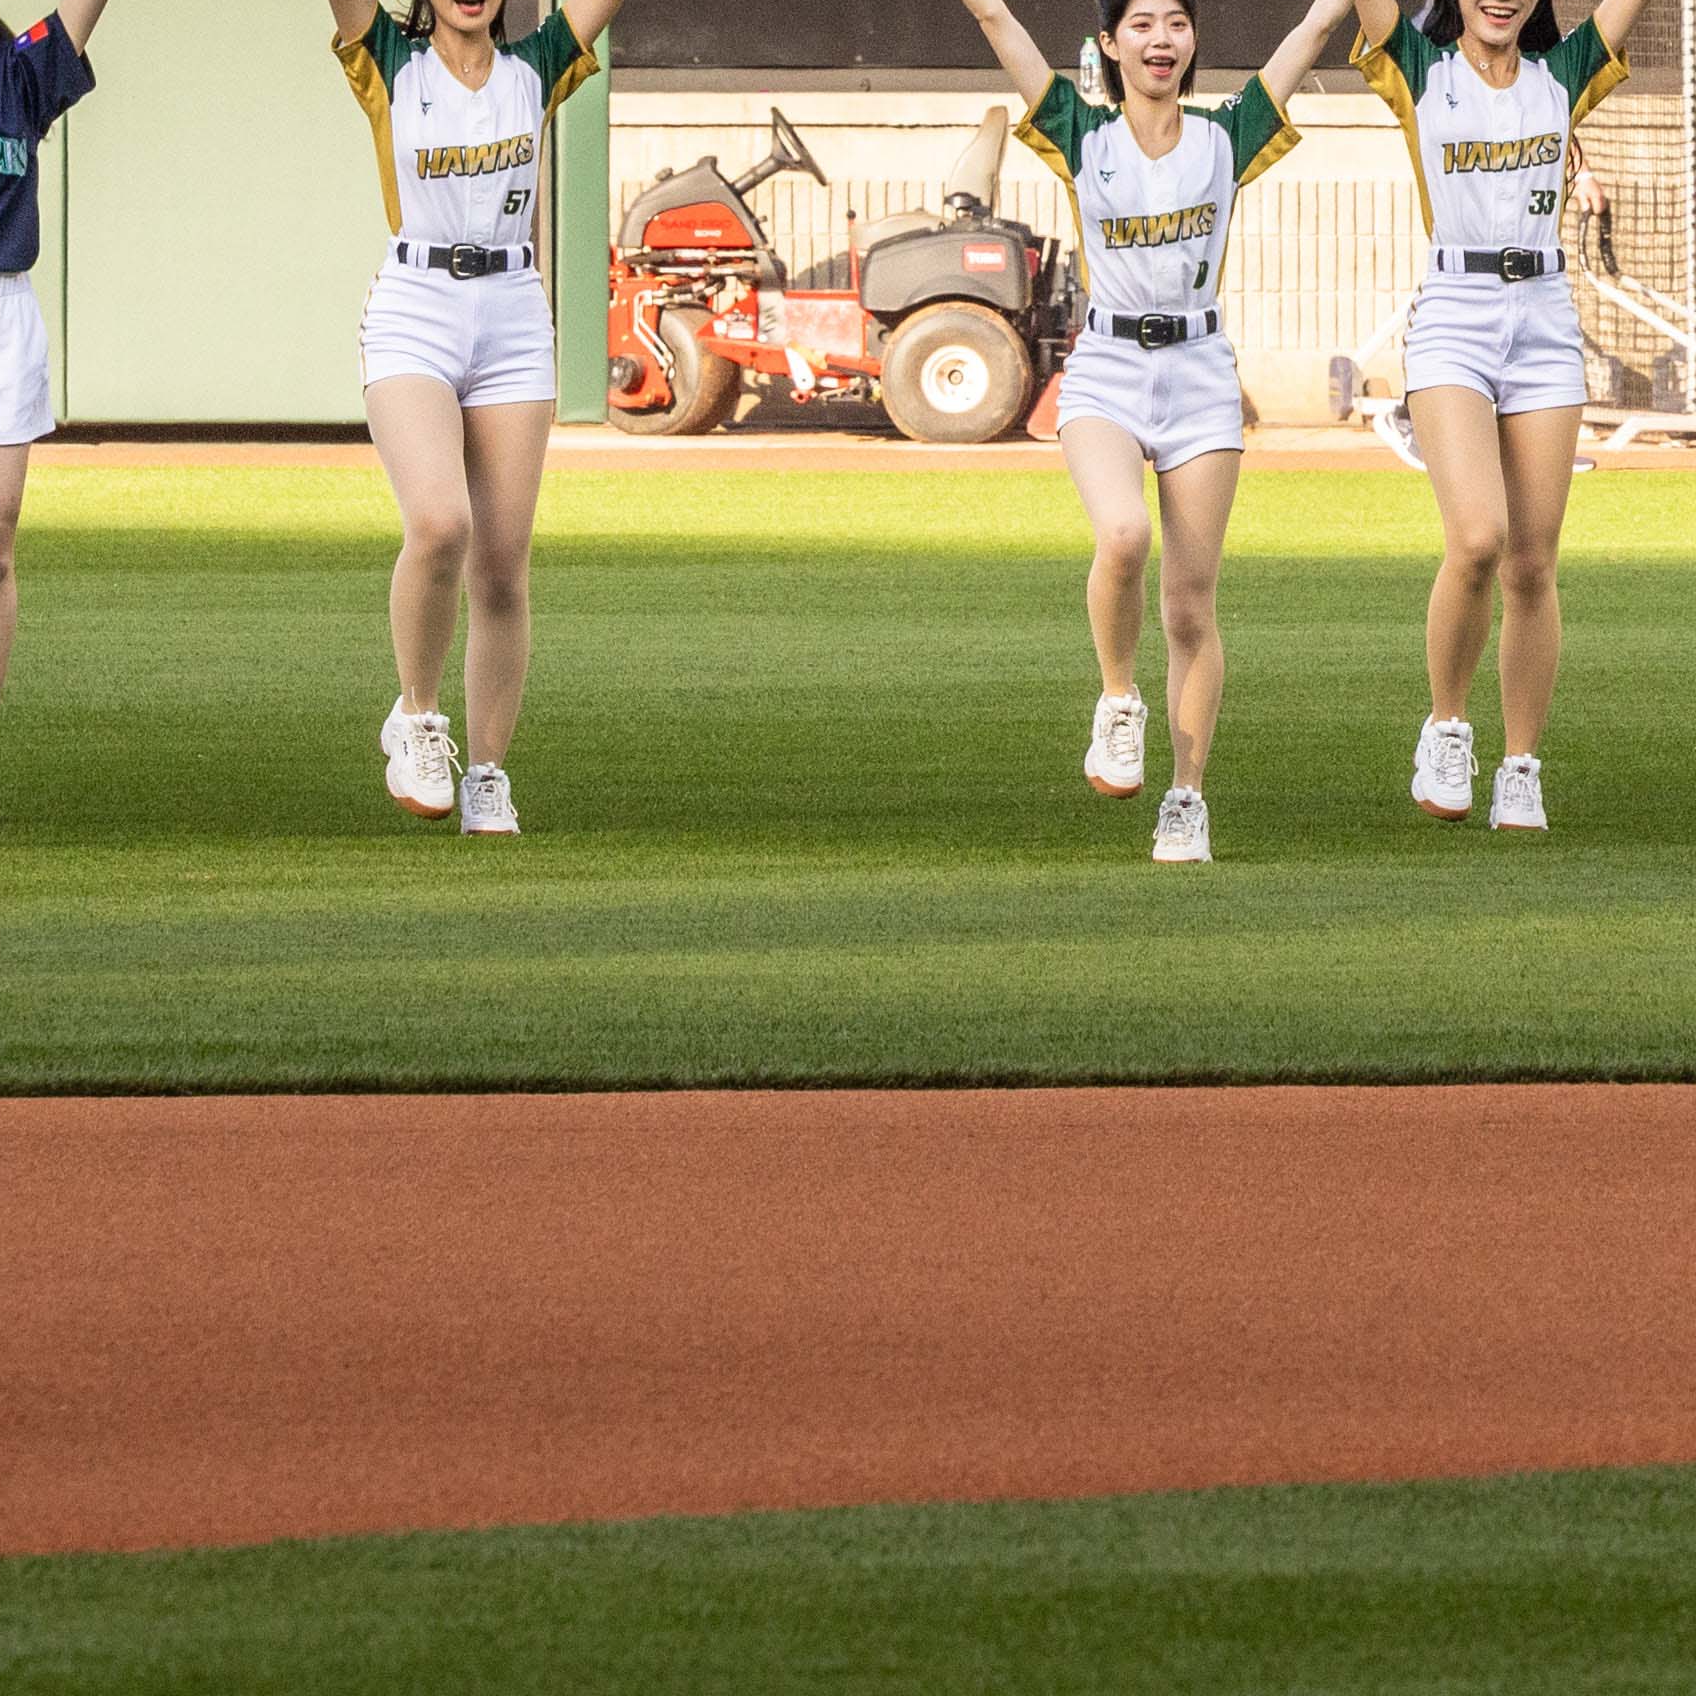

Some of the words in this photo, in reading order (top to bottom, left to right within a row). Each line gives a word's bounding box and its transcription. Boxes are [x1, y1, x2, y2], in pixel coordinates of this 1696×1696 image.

[414, 131, 534, 180] HAWKS
[1441, 131, 1562, 175] HAWKS
[1527, 189, 1558, 216] 33
[1099, 202, 1217, 250] HAWKS
